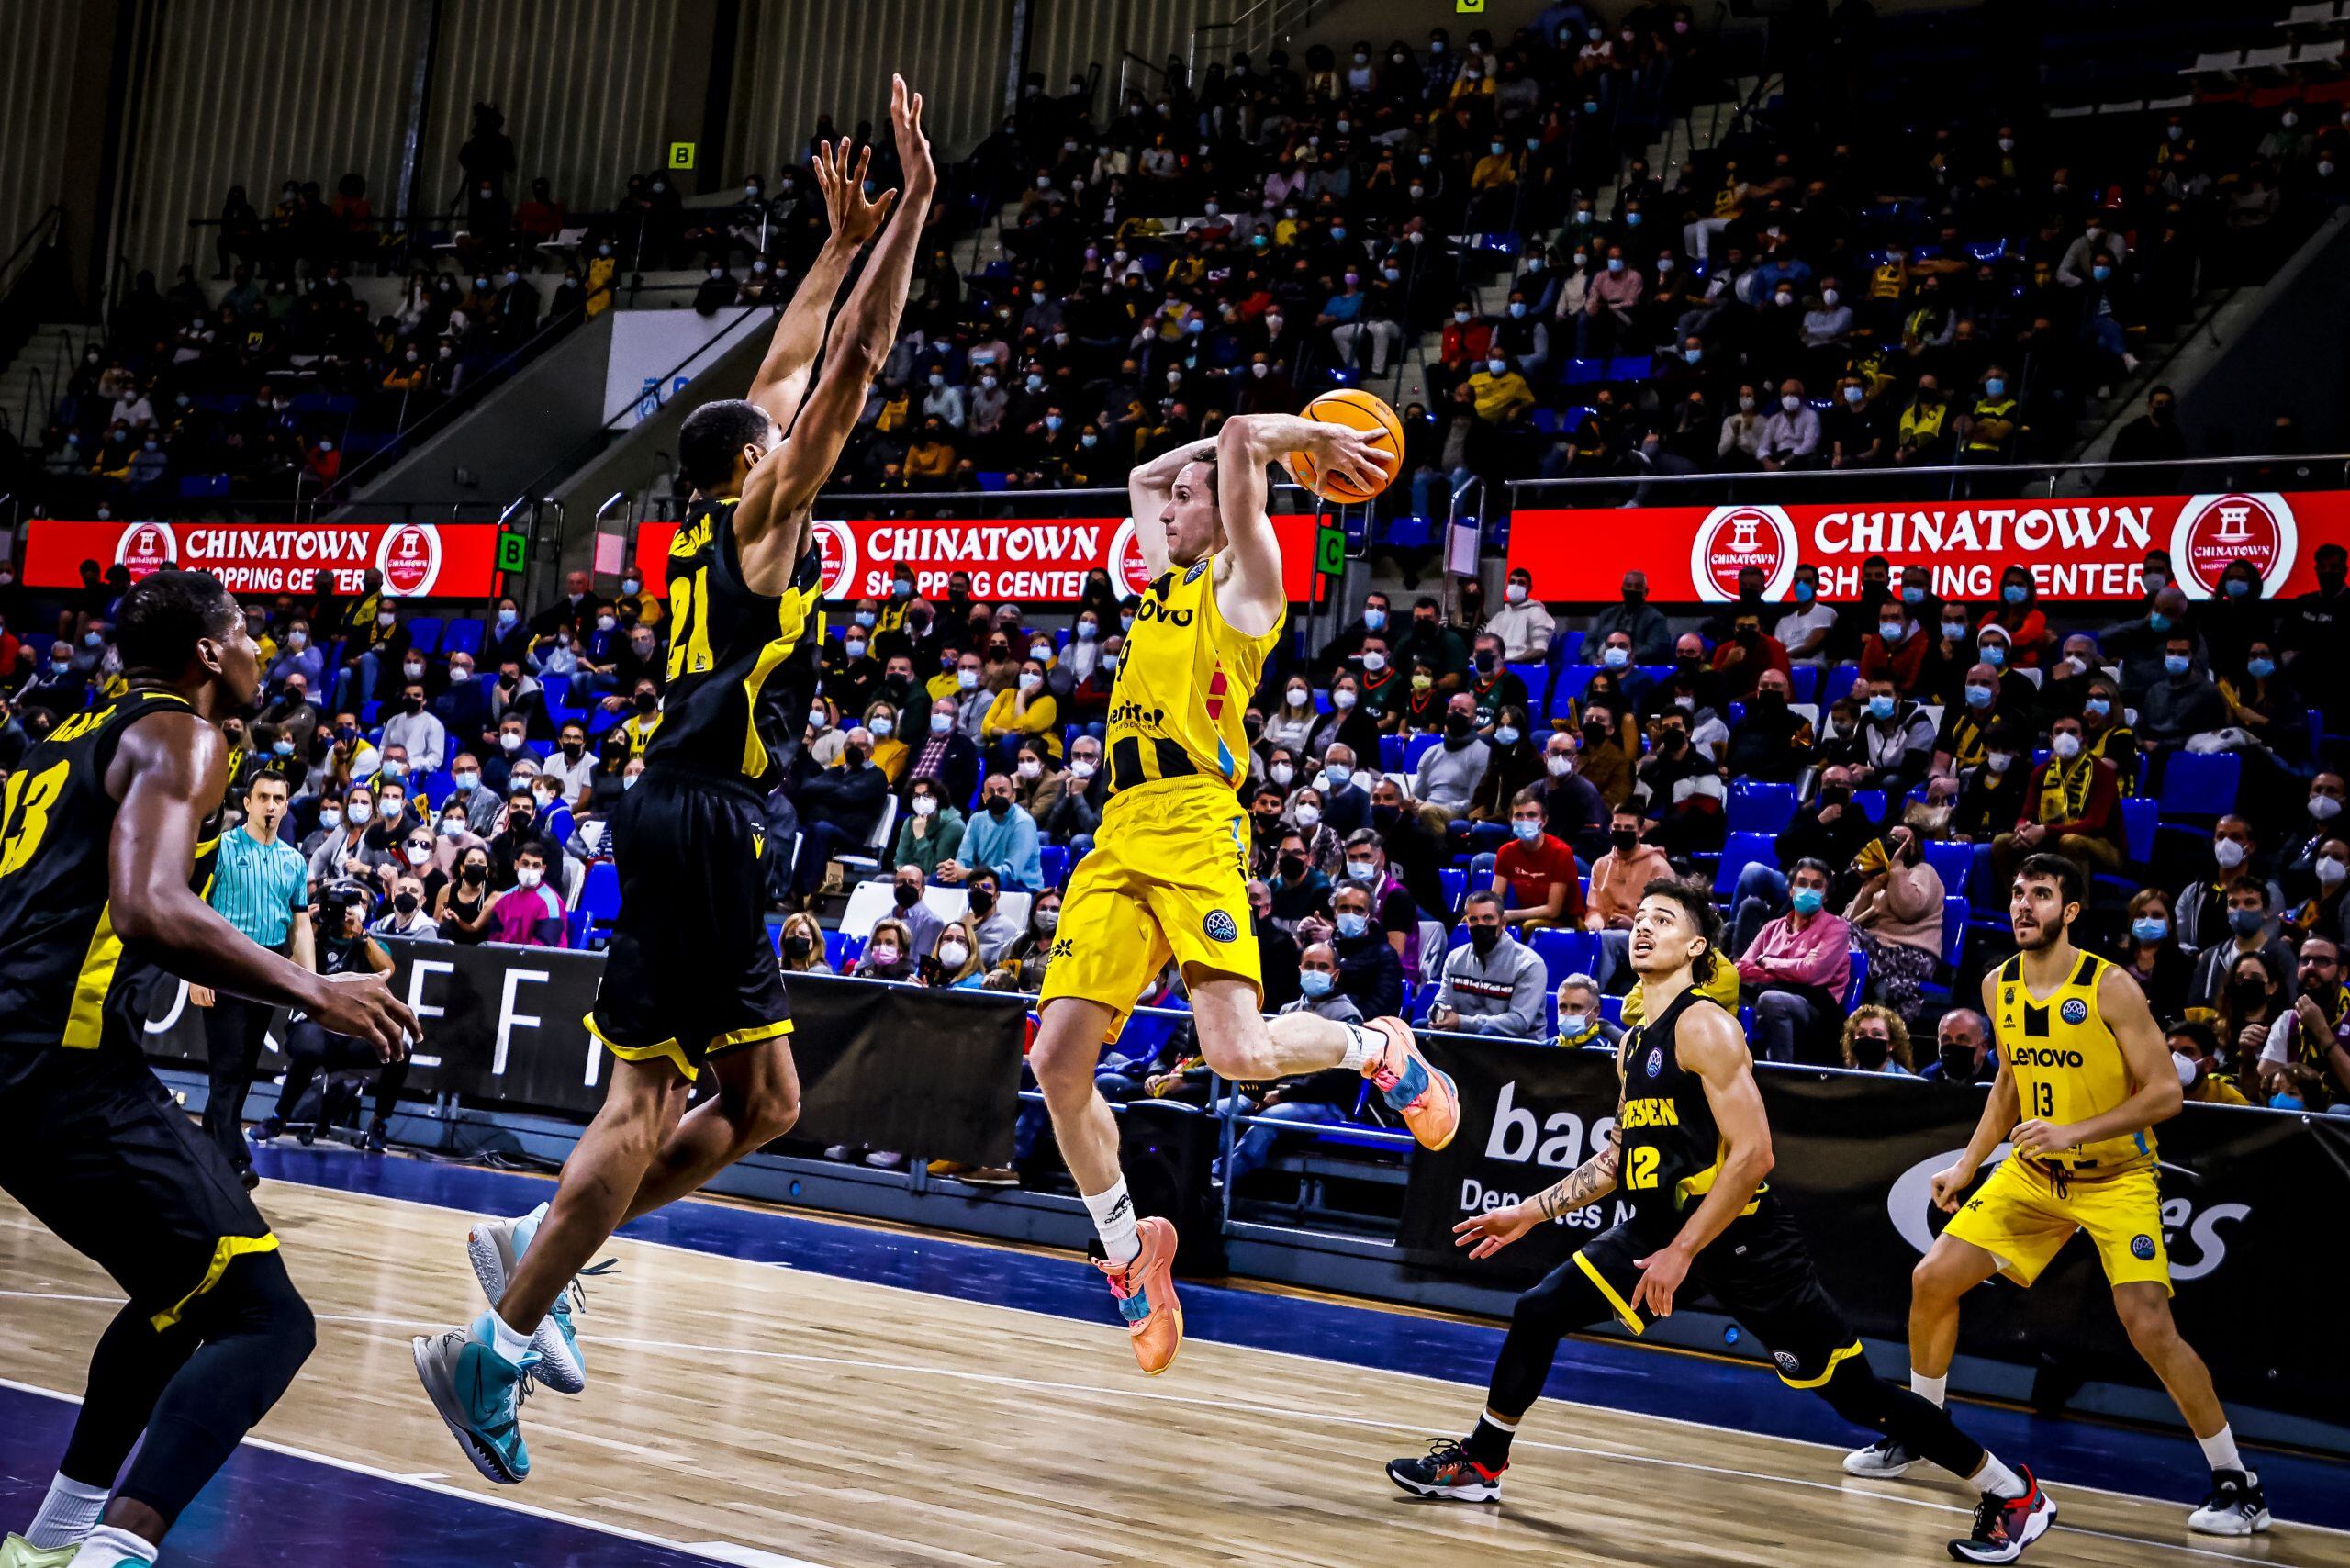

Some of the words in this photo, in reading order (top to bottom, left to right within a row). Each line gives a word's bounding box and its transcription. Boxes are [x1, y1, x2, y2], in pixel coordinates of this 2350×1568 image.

[676, 147, 688, 163] B
[185, 529, 370, 562] CHINATOWN
[867, 526, 1100, 562] CHINATOWN
[1814, 506, 2154, 554] CHINATOWN
[506, 540, 520, 564] B
[1326, 537, 1339, 566] C
[1711, 554, 1776, 565] CHINATOWN
[2194, 545, 2270, 557] CHINATOWN
[185, 566, 283, 591] OPPING
[866, 570, 990, 597] SHPPG
[1816, 565, 1992, 596] SHPING
[2014, 563, 2148, 595] ENTER
[666, 566, 714, 683] 21
[0, 759, 70, 879] 13
[2007, 1043, 2084, 1068] Lenovo
[2033, 1081, 2053, 1117] 13
[1626, 1146, 1661, 1191] 12
